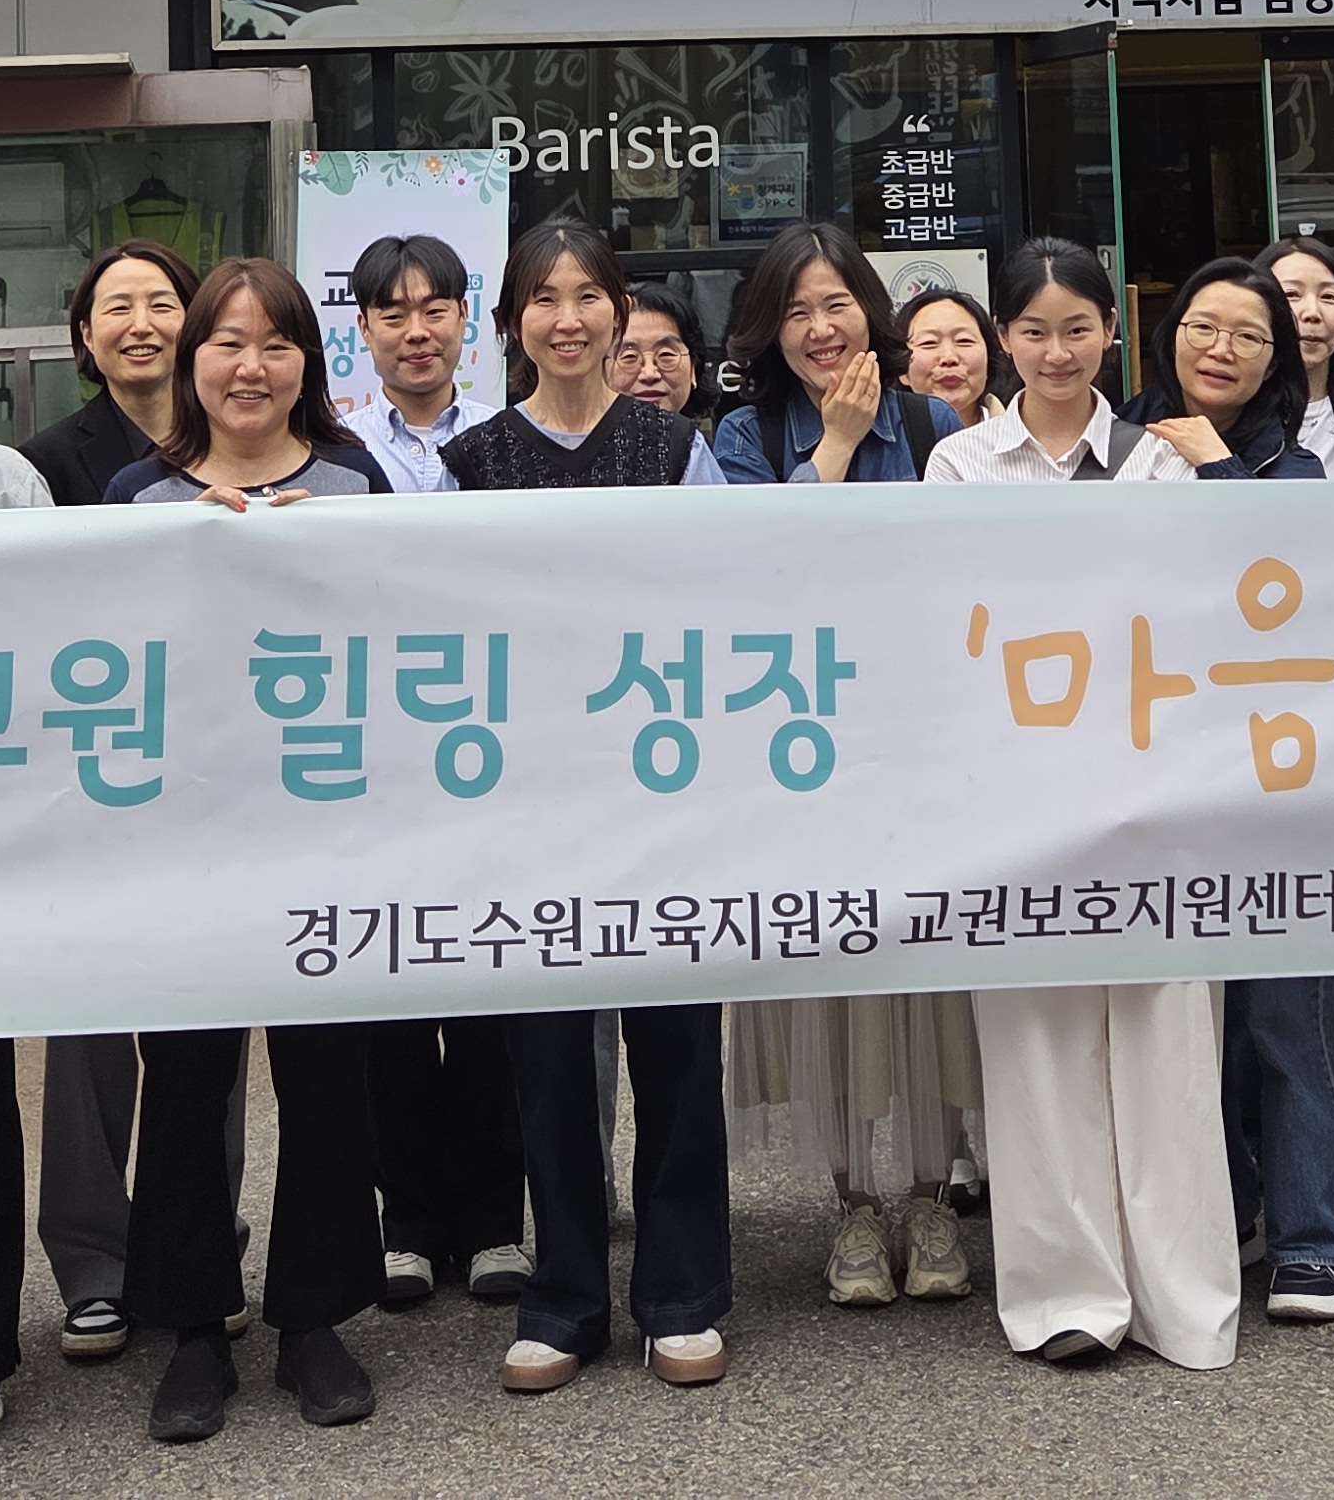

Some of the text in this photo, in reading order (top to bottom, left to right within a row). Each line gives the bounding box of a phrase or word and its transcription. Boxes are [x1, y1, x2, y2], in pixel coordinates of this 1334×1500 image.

[491, 112, 720, 173] Barista
[880, 148, 955, 176] 초급반
[881, 181, 956, 210] 중급반
[883, 214, 958, 241] 고급반
[250, 628, 508, 802] 힐링
[586, 628, 856, 793] 성장
[285, 888, 879, 977] 경기도수원교육지원청
